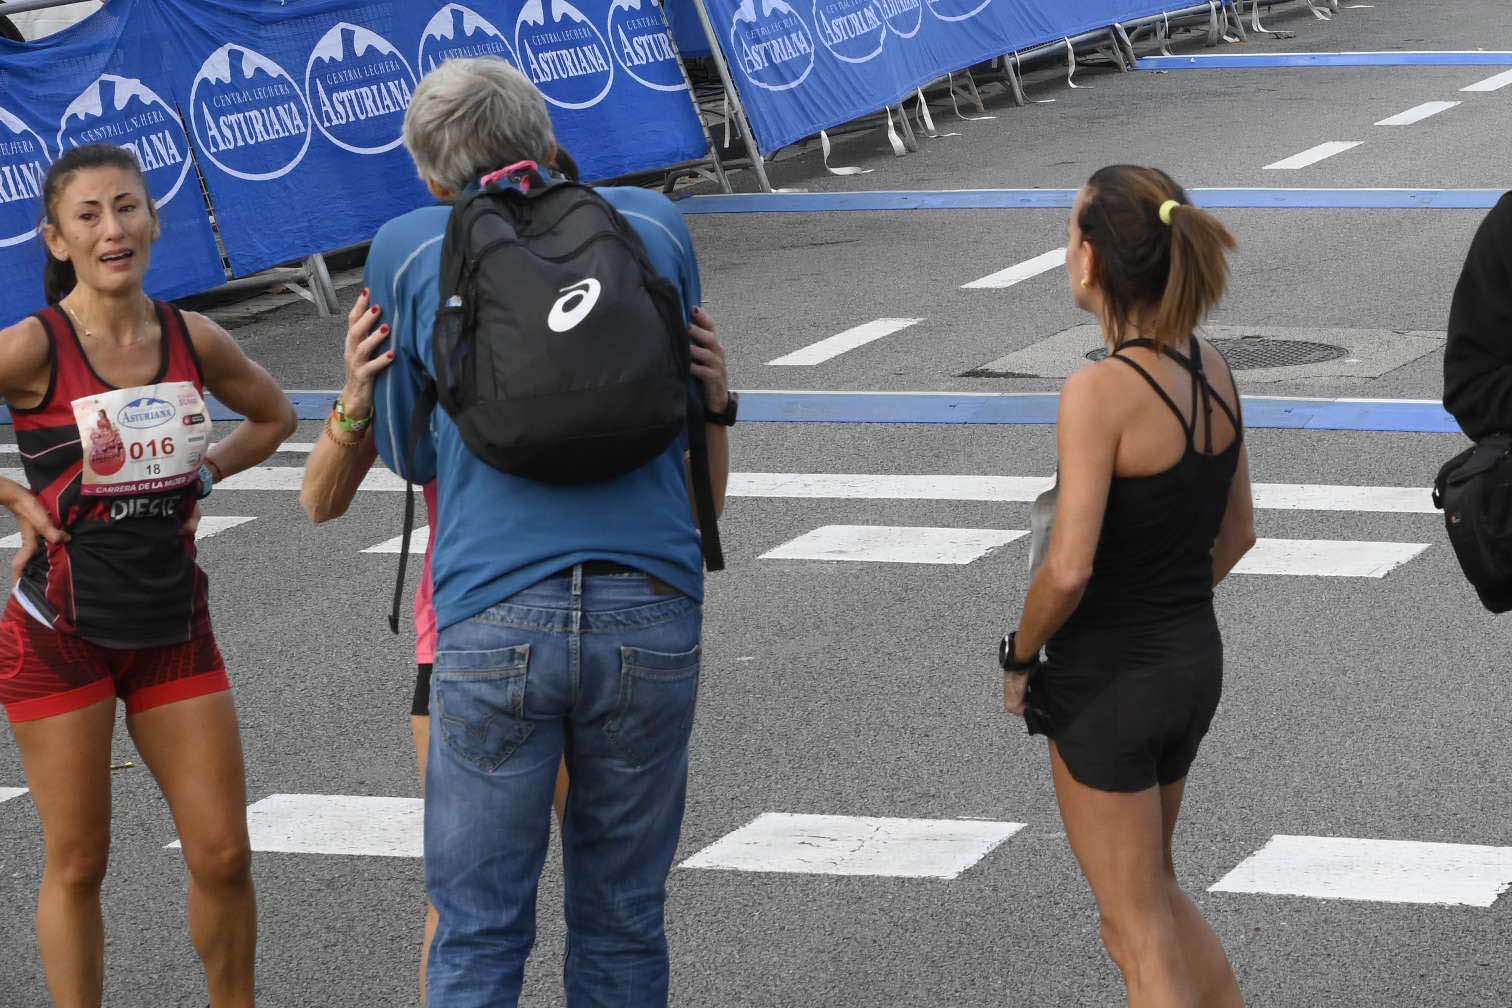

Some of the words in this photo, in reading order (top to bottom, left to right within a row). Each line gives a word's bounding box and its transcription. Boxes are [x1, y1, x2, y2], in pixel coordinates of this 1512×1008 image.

[532, 31, 562, 45] CENTRAL
[563, 27, 593, 40] LECHERA
[326, 68, 362, 86] CENTRAL
[364, 60, 400, 79] LECHERA
[523, 39, 609, 84] ASTURIANA
[213, 90, 252, 108] CENTRAL
[254, 83, 290, 101] LECHERA
[315, 77, 413, 128] ASTURIANA
[202, 102, 306, 153] ASTURIANA
[122, 408, 172, 424] ASTURIANA
[130, 437, 175, 460] 016
[146, 464, 160, 475] 18
[96, 484, 136, 494] CARRERA
[138, 482, 150, 491] DE
[151, 481, 163, 489] LA
